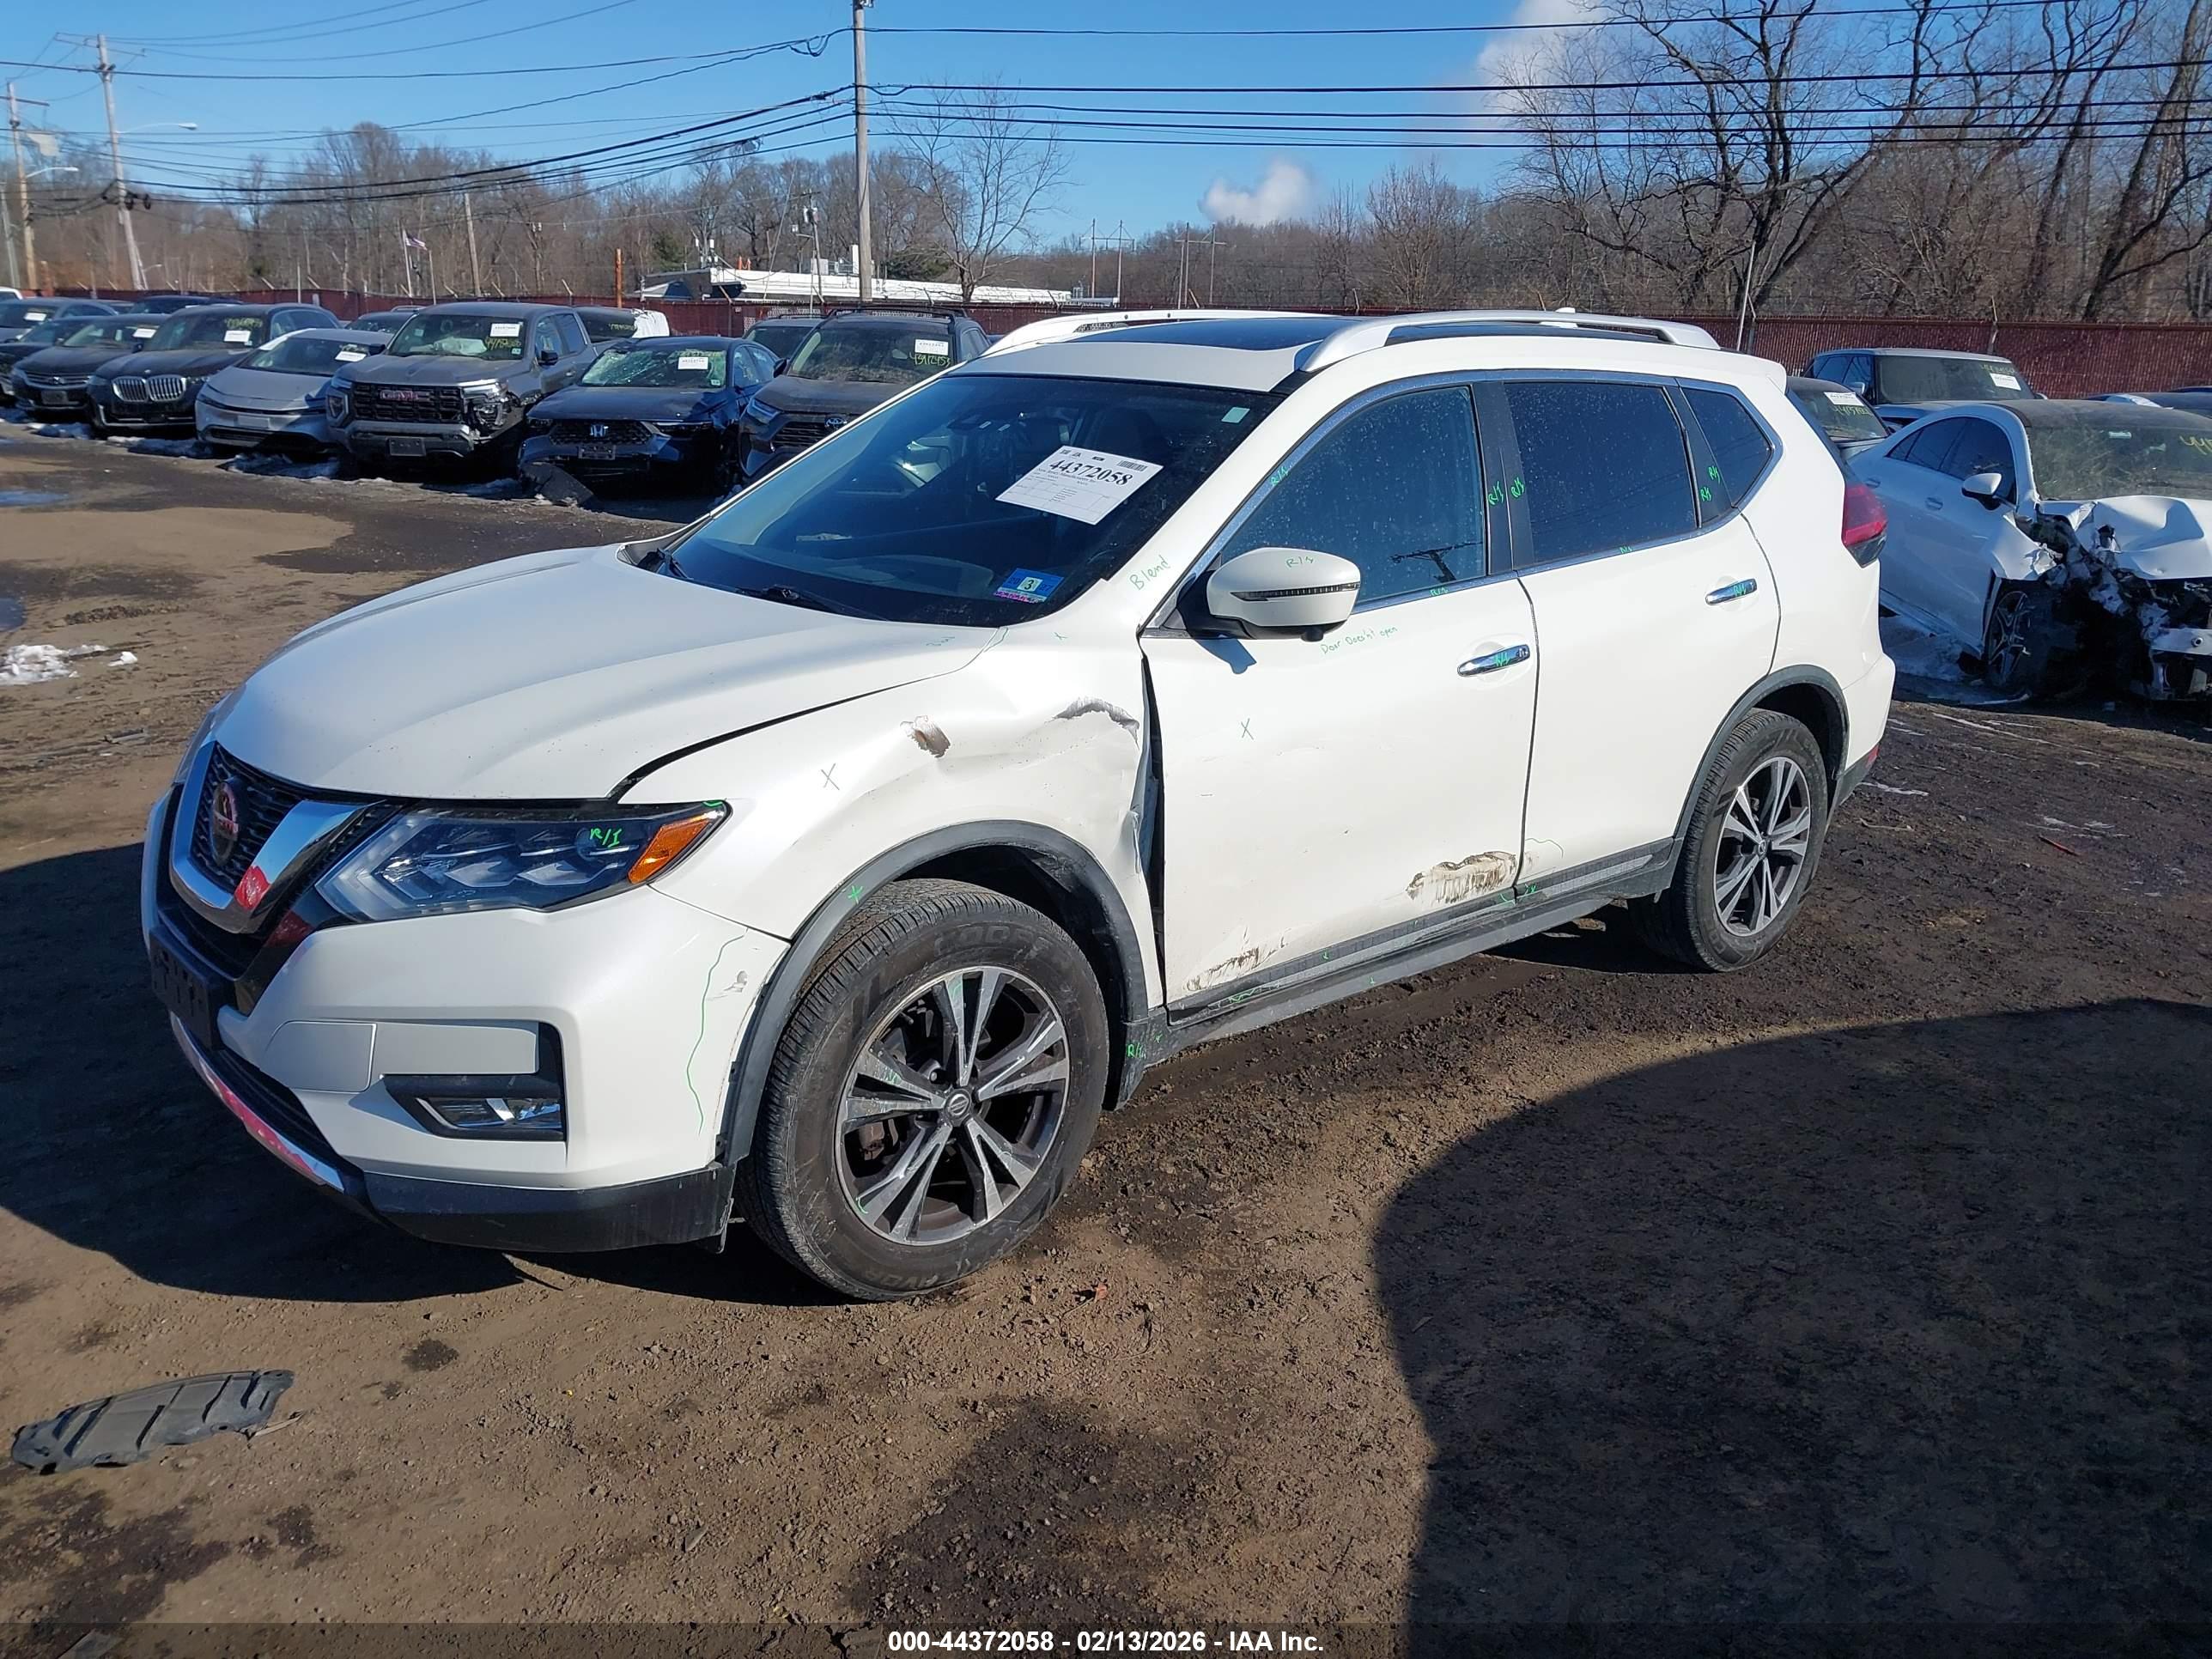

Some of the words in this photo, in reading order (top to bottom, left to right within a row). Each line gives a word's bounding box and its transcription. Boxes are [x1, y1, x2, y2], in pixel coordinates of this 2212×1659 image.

[1049, 459, 1133, 486] 44372058
[1129, 554, 1171, 590] Blend
[1024, 579, 1035, 591] 3
[1379, 626, 1399, 638] open
[590, 828, 623, 848] R/I
